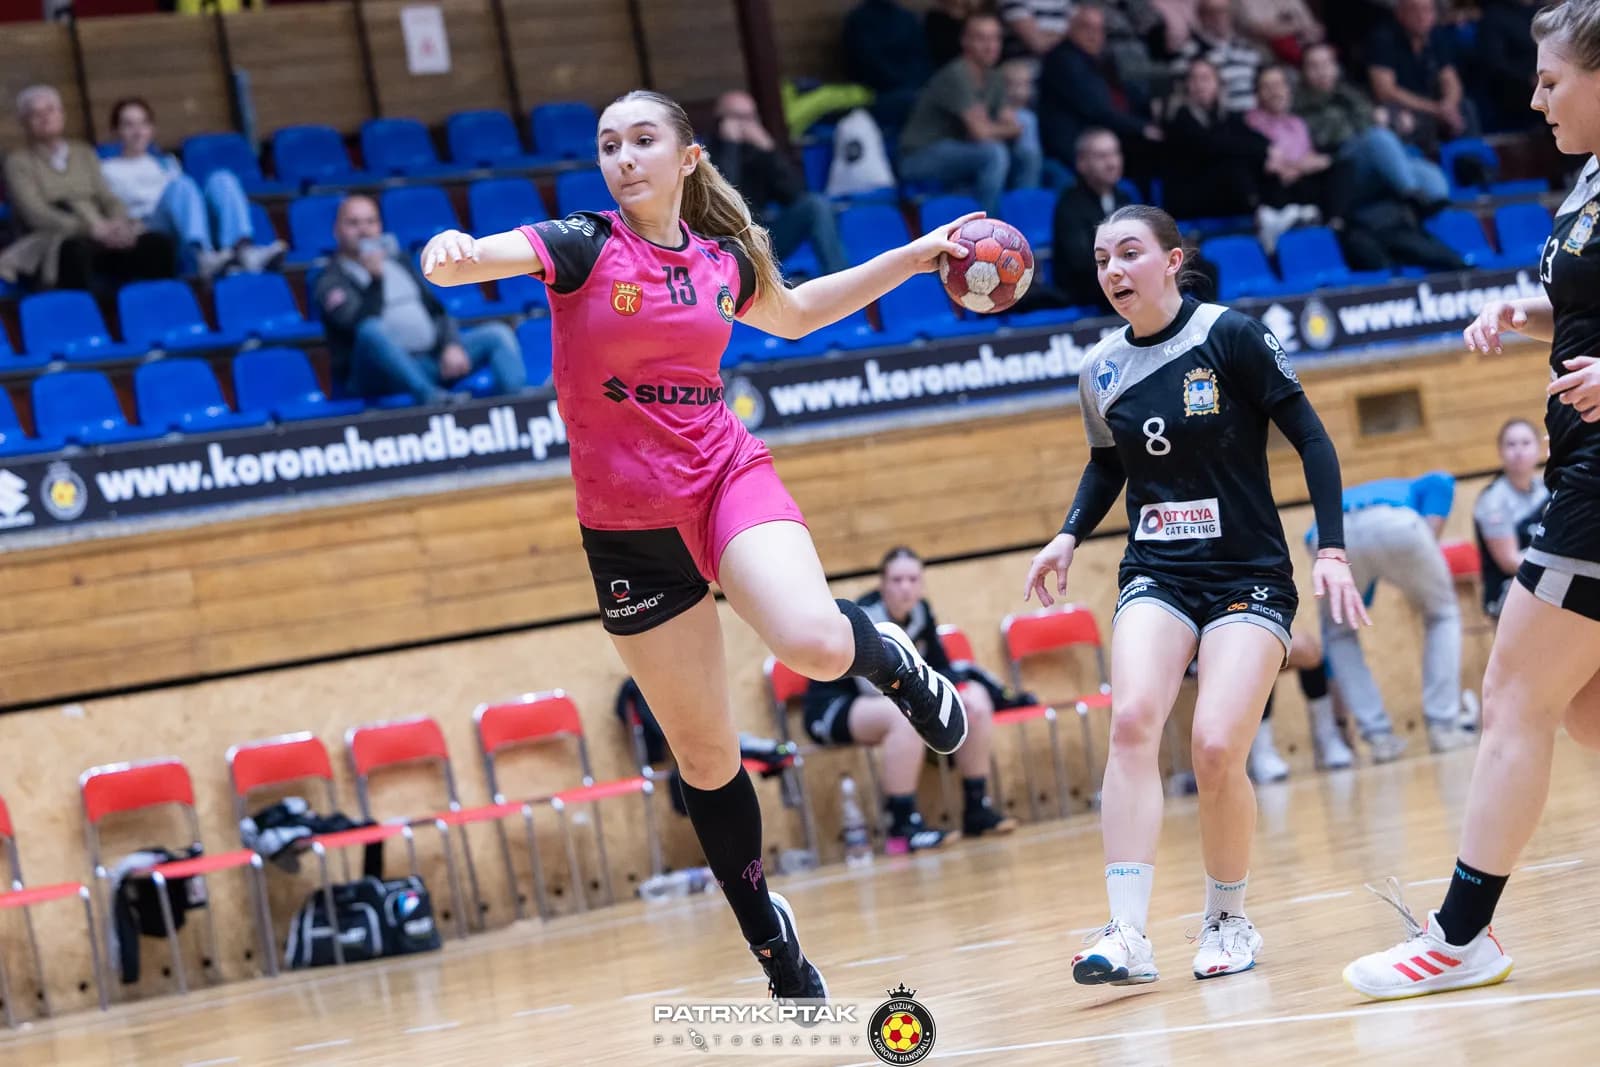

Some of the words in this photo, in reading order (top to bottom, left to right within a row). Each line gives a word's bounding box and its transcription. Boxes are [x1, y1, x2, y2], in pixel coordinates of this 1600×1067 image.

[662, 265, 697, 306] 13
[614, 294, 637, 313] CK
[1143, 416, 1172, 456] 8
[95, 400, 567, 503] www.koronahandball.pl
[1163, 508, 1213, 522] OTYLYA
[1165, 524, 1216, 536] CATERING
[604, 596, 659, 618] karabela
